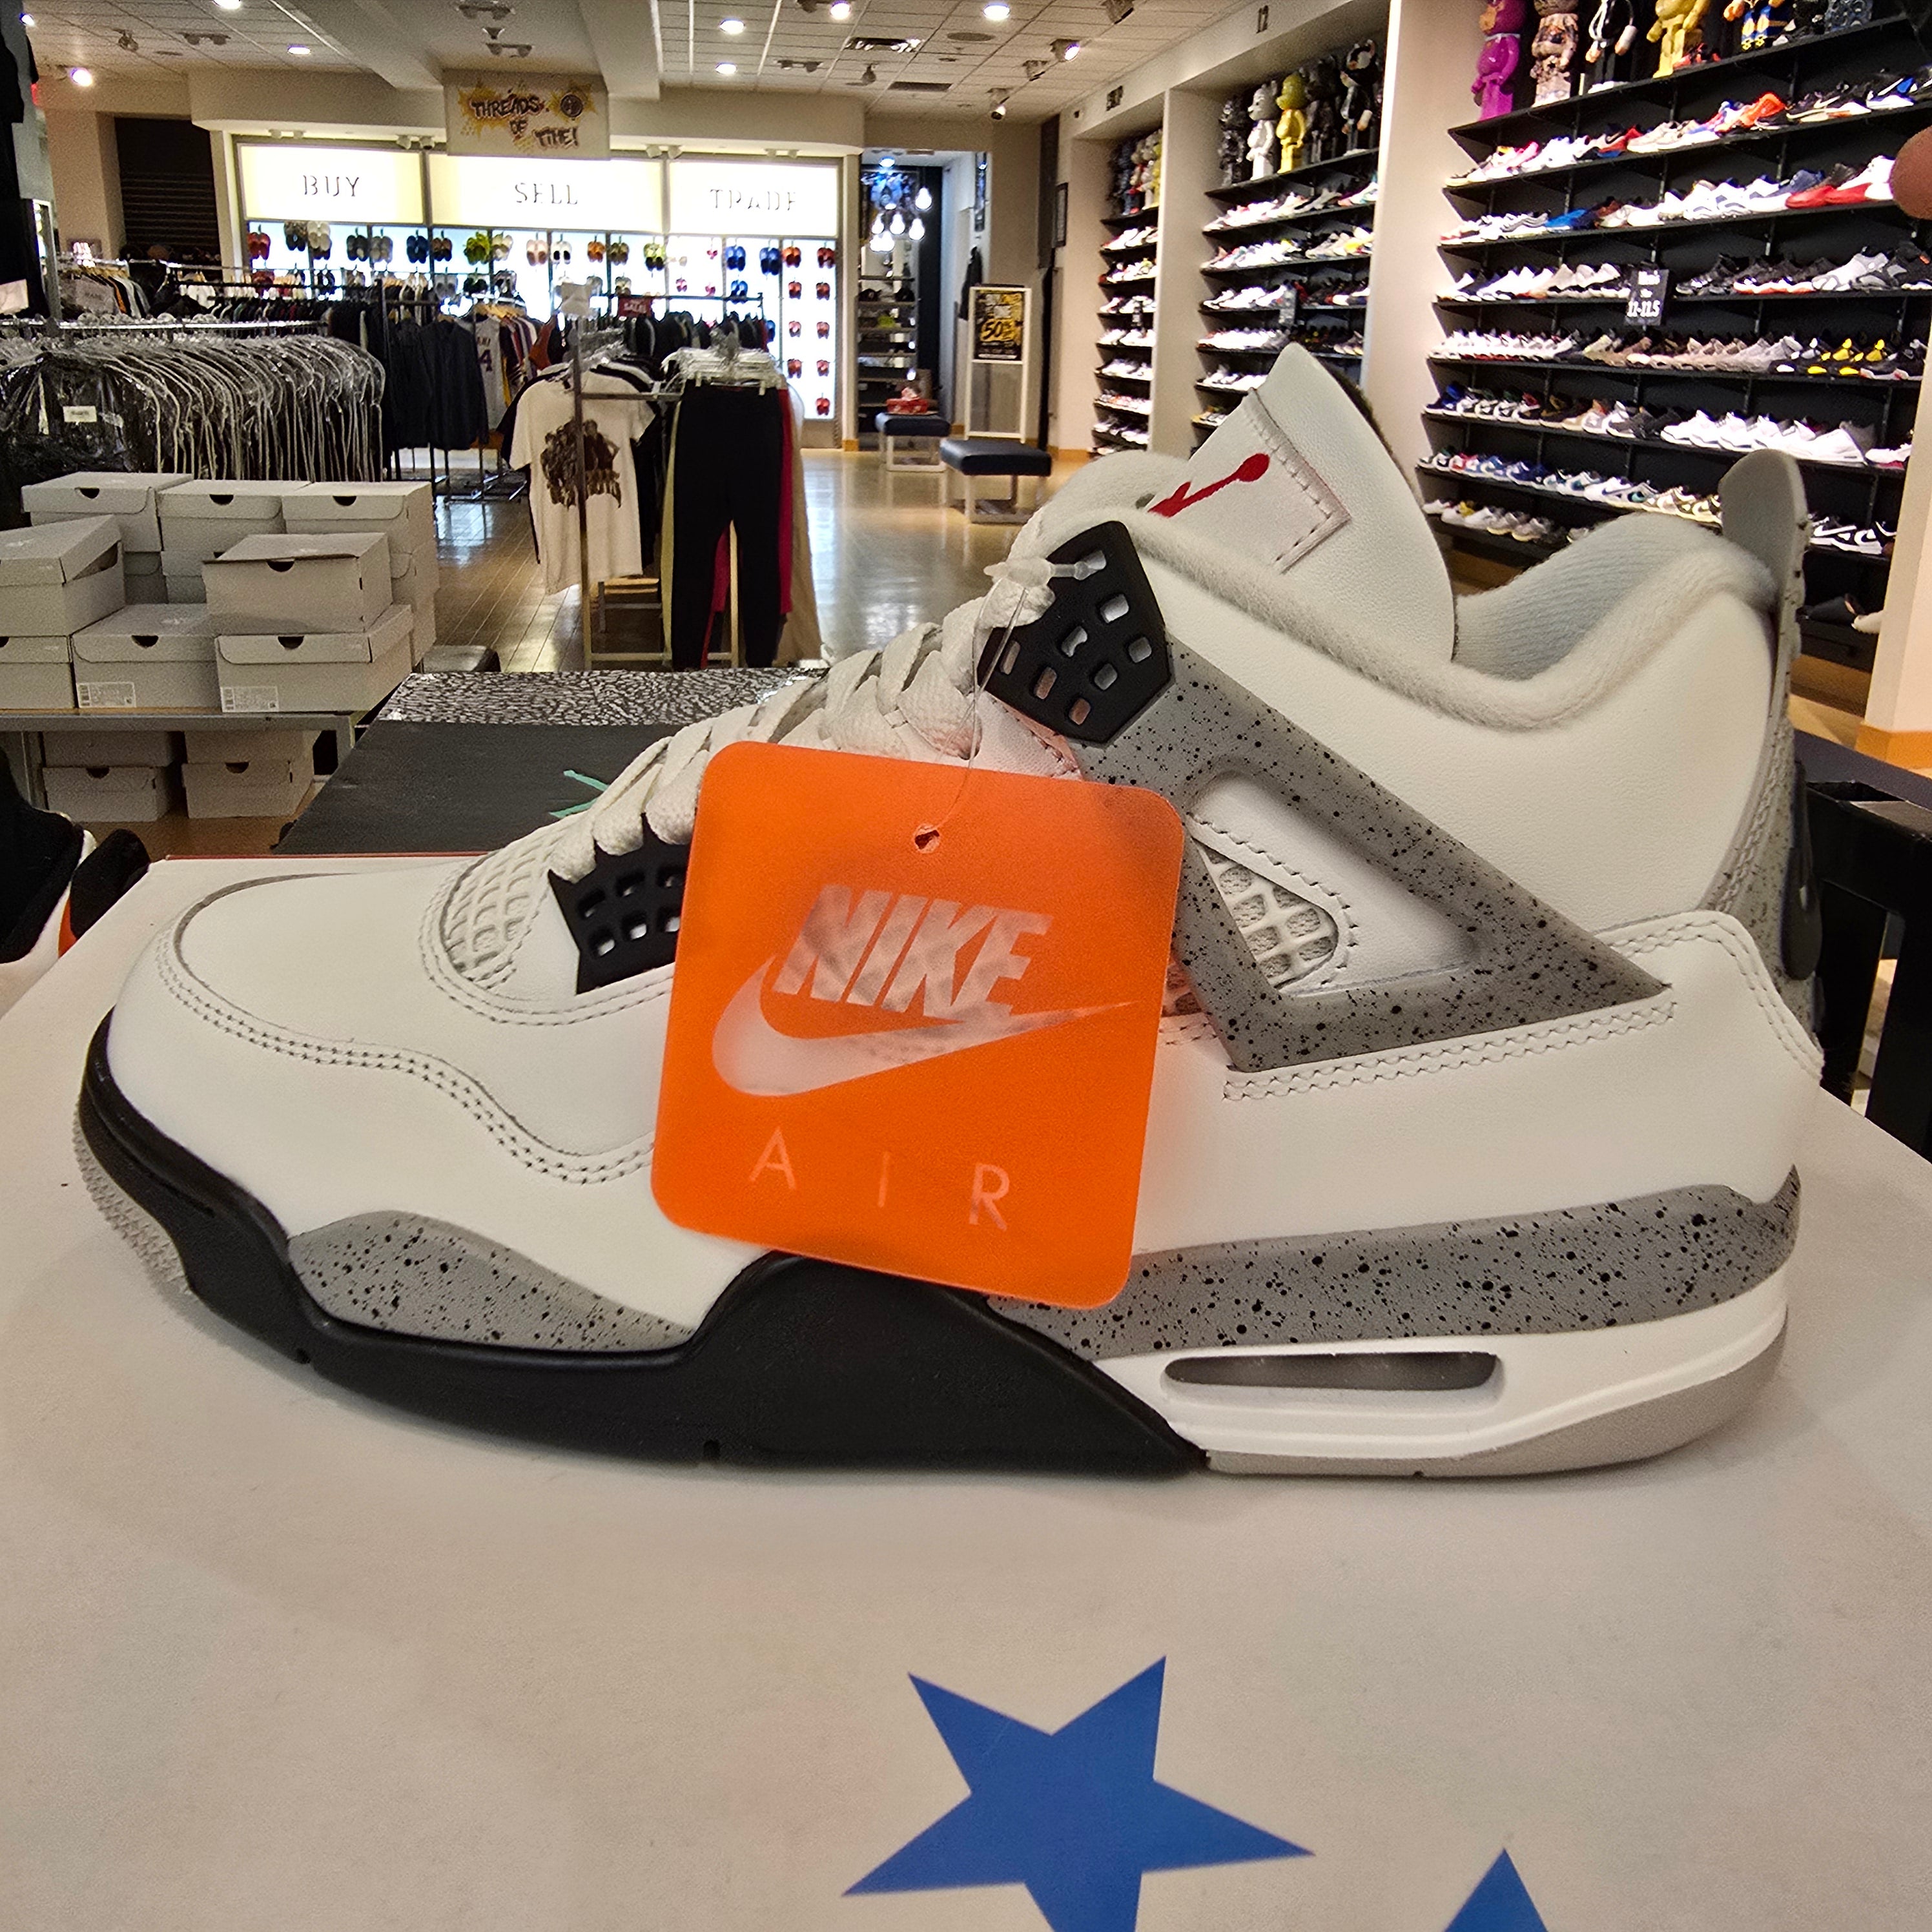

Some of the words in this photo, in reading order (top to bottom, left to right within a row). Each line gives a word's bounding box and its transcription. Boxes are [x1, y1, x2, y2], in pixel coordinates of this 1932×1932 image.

[303, 175, 359, 196] BUY
[515, 182, 578, 205] SELL
[774, 884, 1054, 1020] NIKE
[749, 1126, 1011, 1231] AIR
